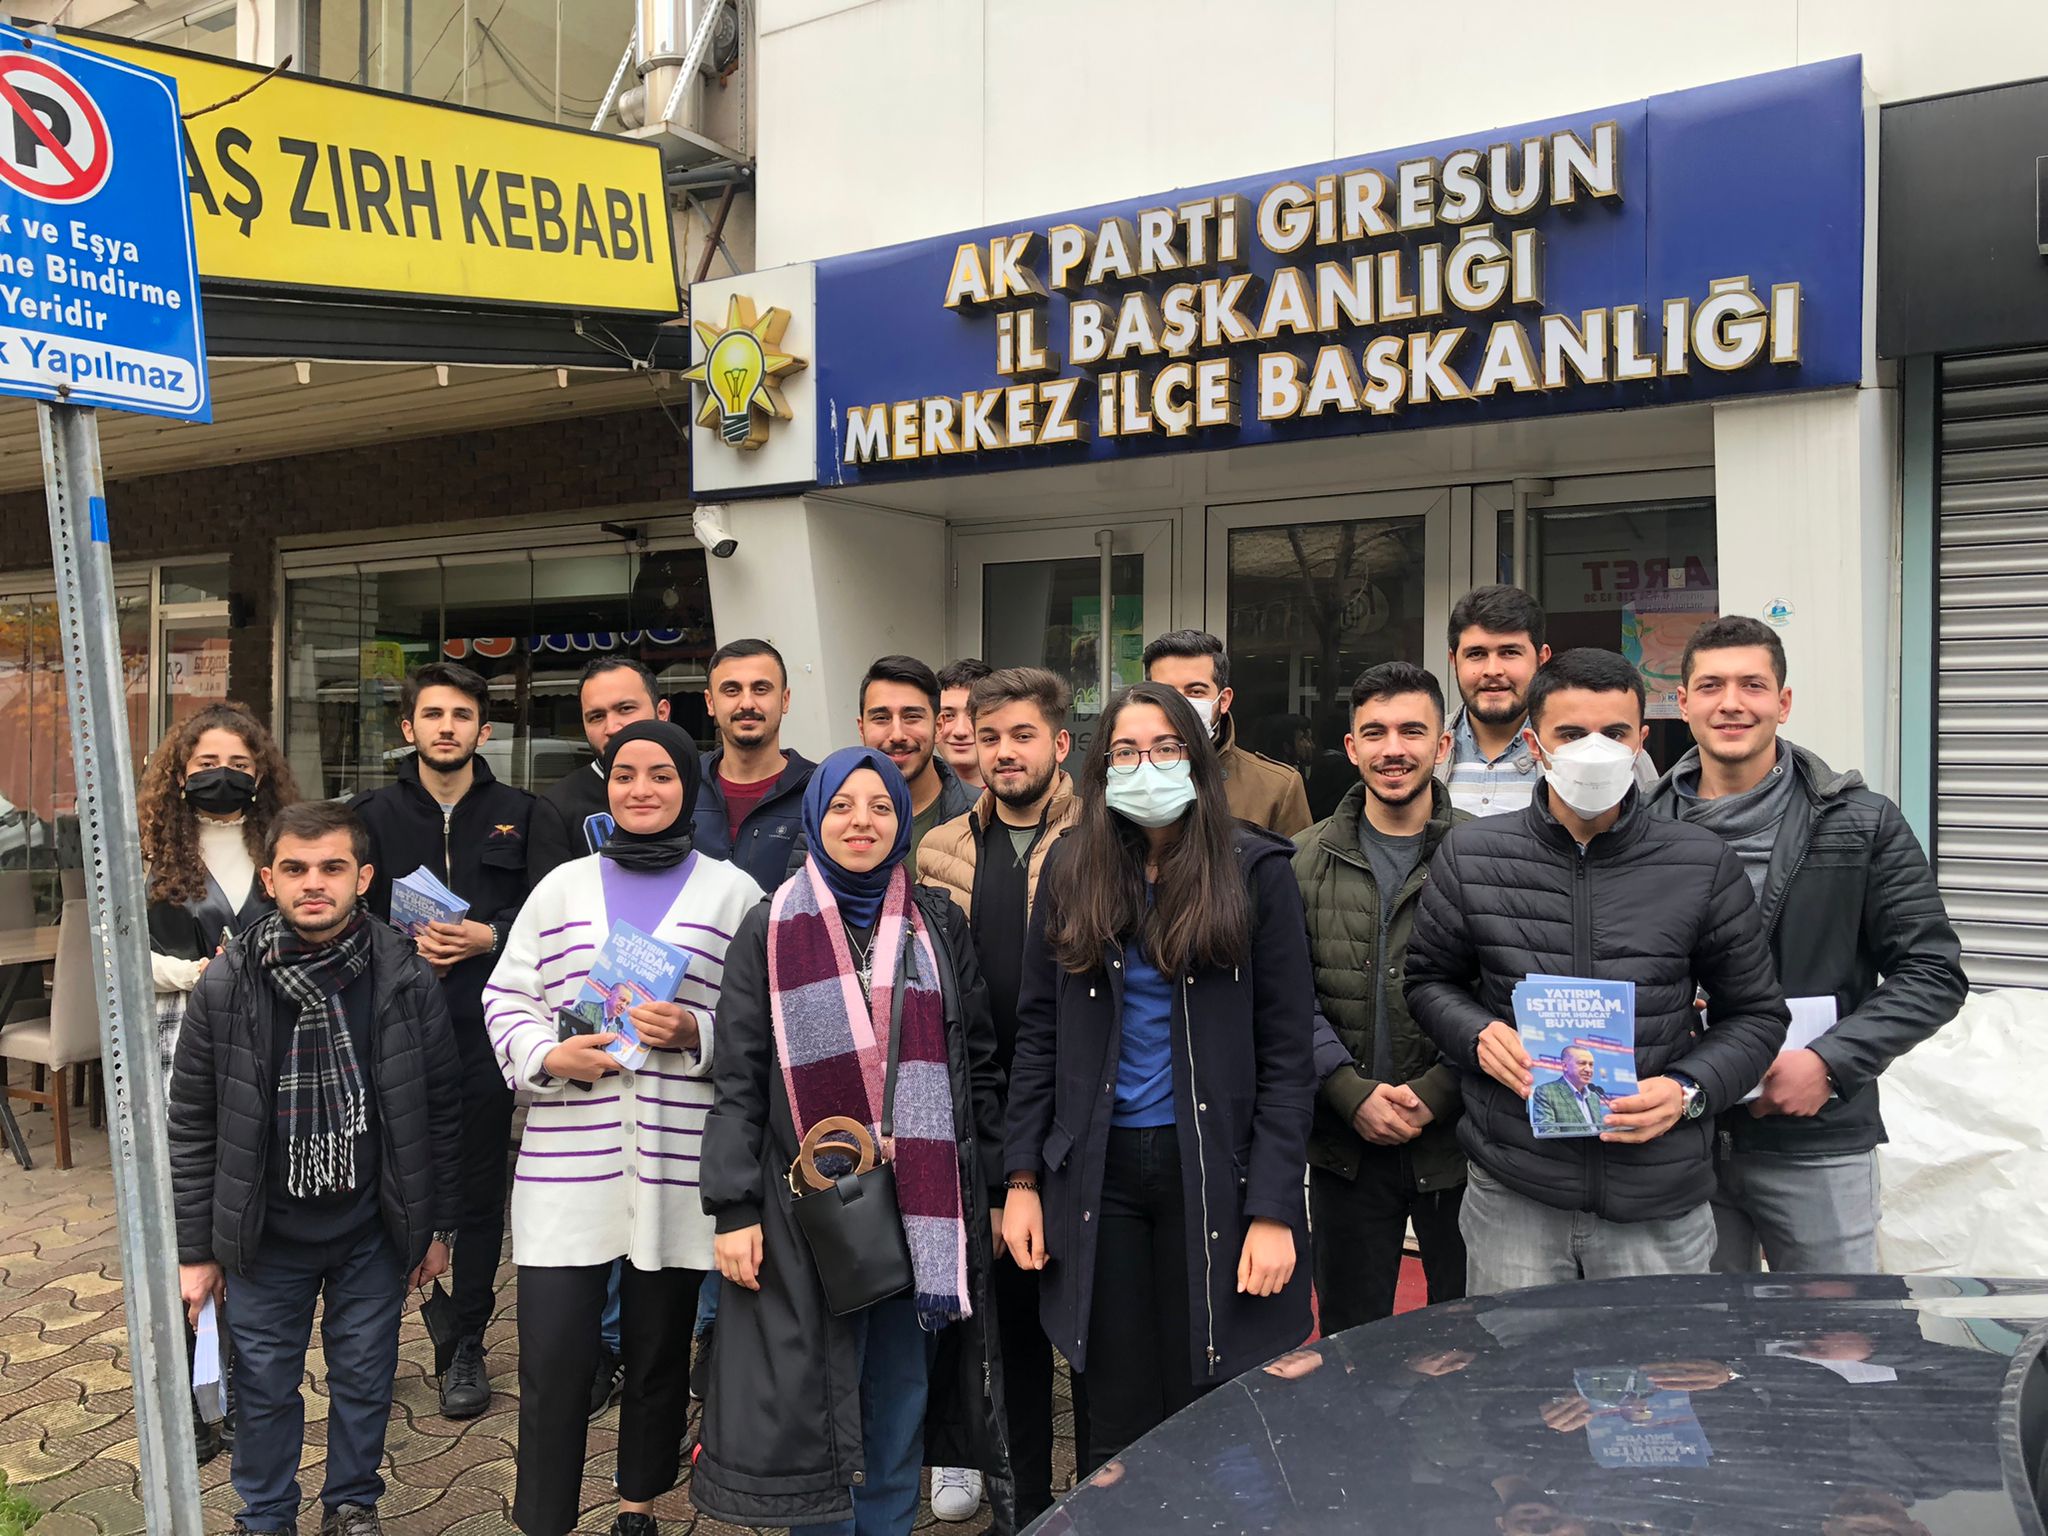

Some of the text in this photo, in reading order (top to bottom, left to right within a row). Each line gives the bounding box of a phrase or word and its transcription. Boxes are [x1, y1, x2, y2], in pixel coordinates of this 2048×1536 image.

[279, 136, 443, 242] ZIRH
[455, 164, 655, 265] KEBABI
[22, 217, 59, 244] ve
[69, 219, 140, 265] Eşya
[944, 231, 1043, 309] AK
[0, 283, 108, 331] Yeridir
[46, 253, 182, 311] Bindirme
[1069, 222, 1542, 366] BAŞKANLIĞI
[20, 336, 186, 393] Yapılmaz
[843, 377, 1085, 466] MERKEZ
[1257, 275, 1801, 421] BAŞKANLIĞI
